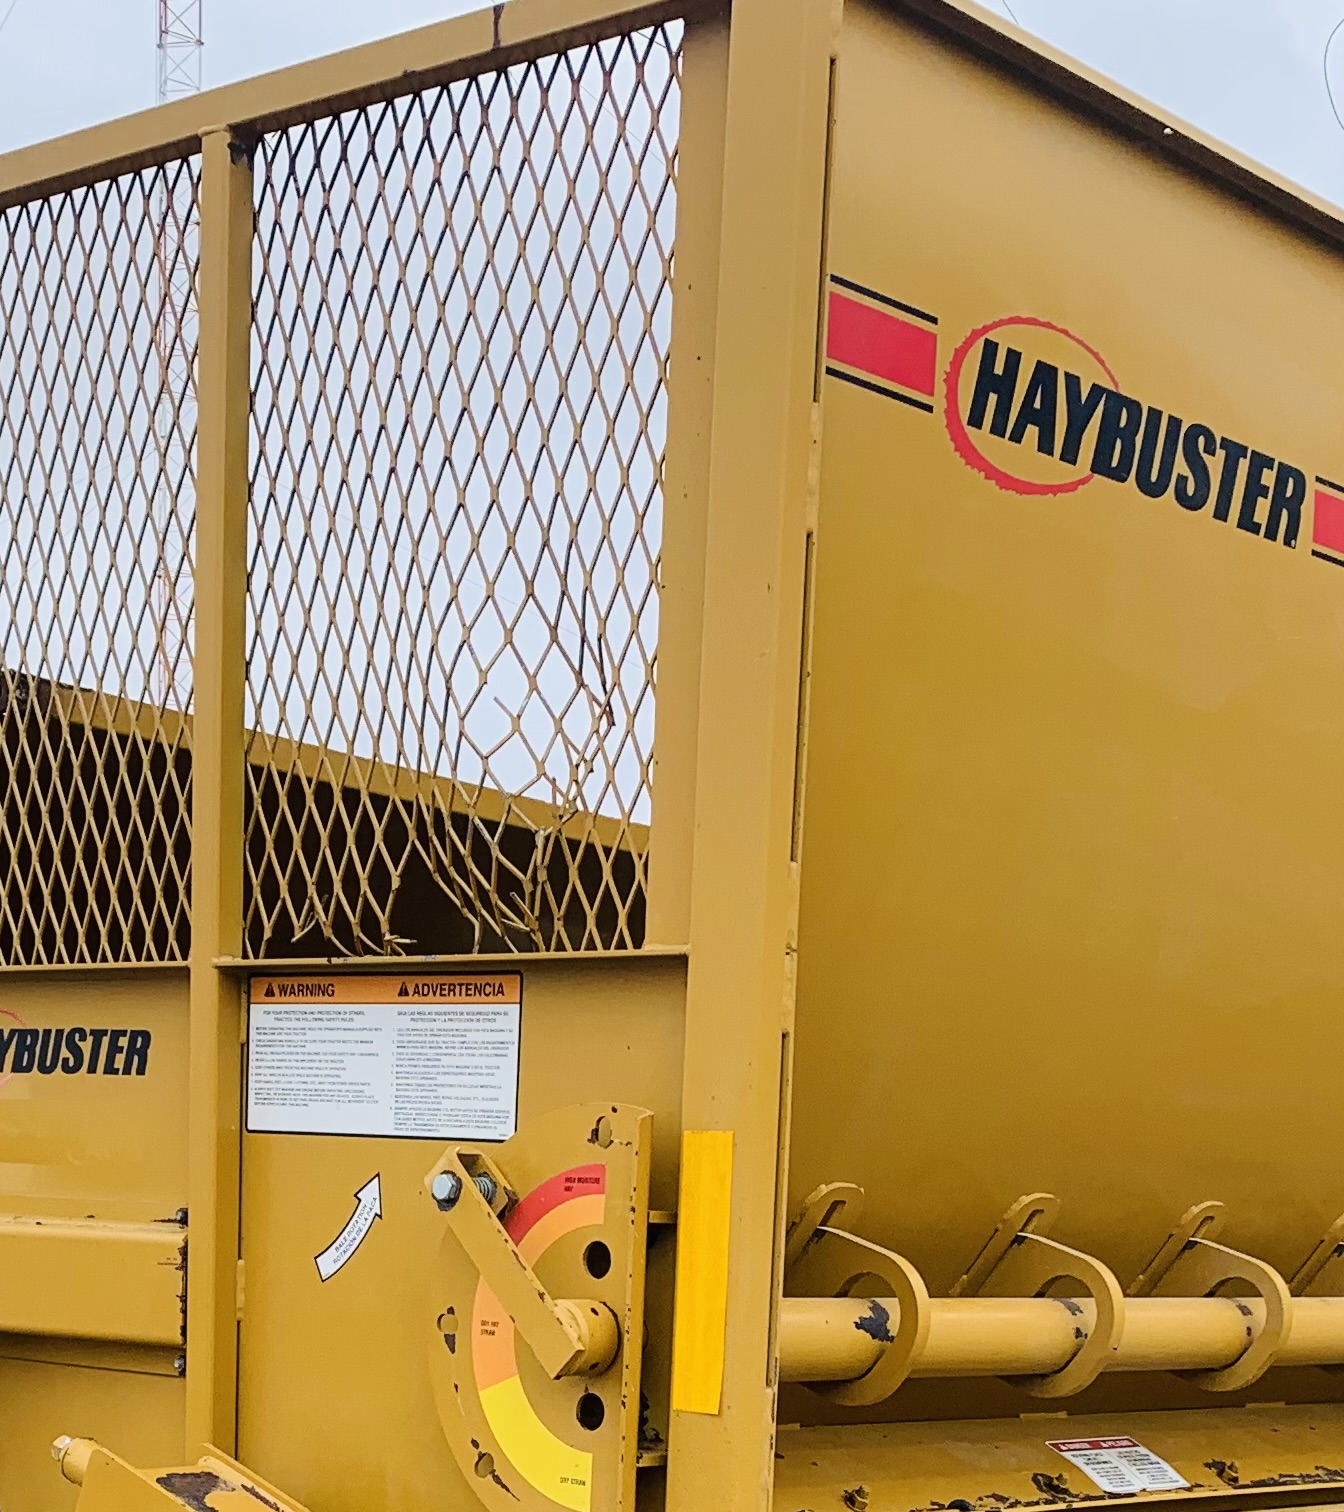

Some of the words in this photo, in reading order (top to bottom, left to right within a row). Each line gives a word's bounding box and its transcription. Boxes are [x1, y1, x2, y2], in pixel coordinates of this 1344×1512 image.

[967, 336, 1308, 549] HAYBUSTER
[278, 982, 336, 998] WARNING
[412, 982, 505, 998] ADVERTENCIA
